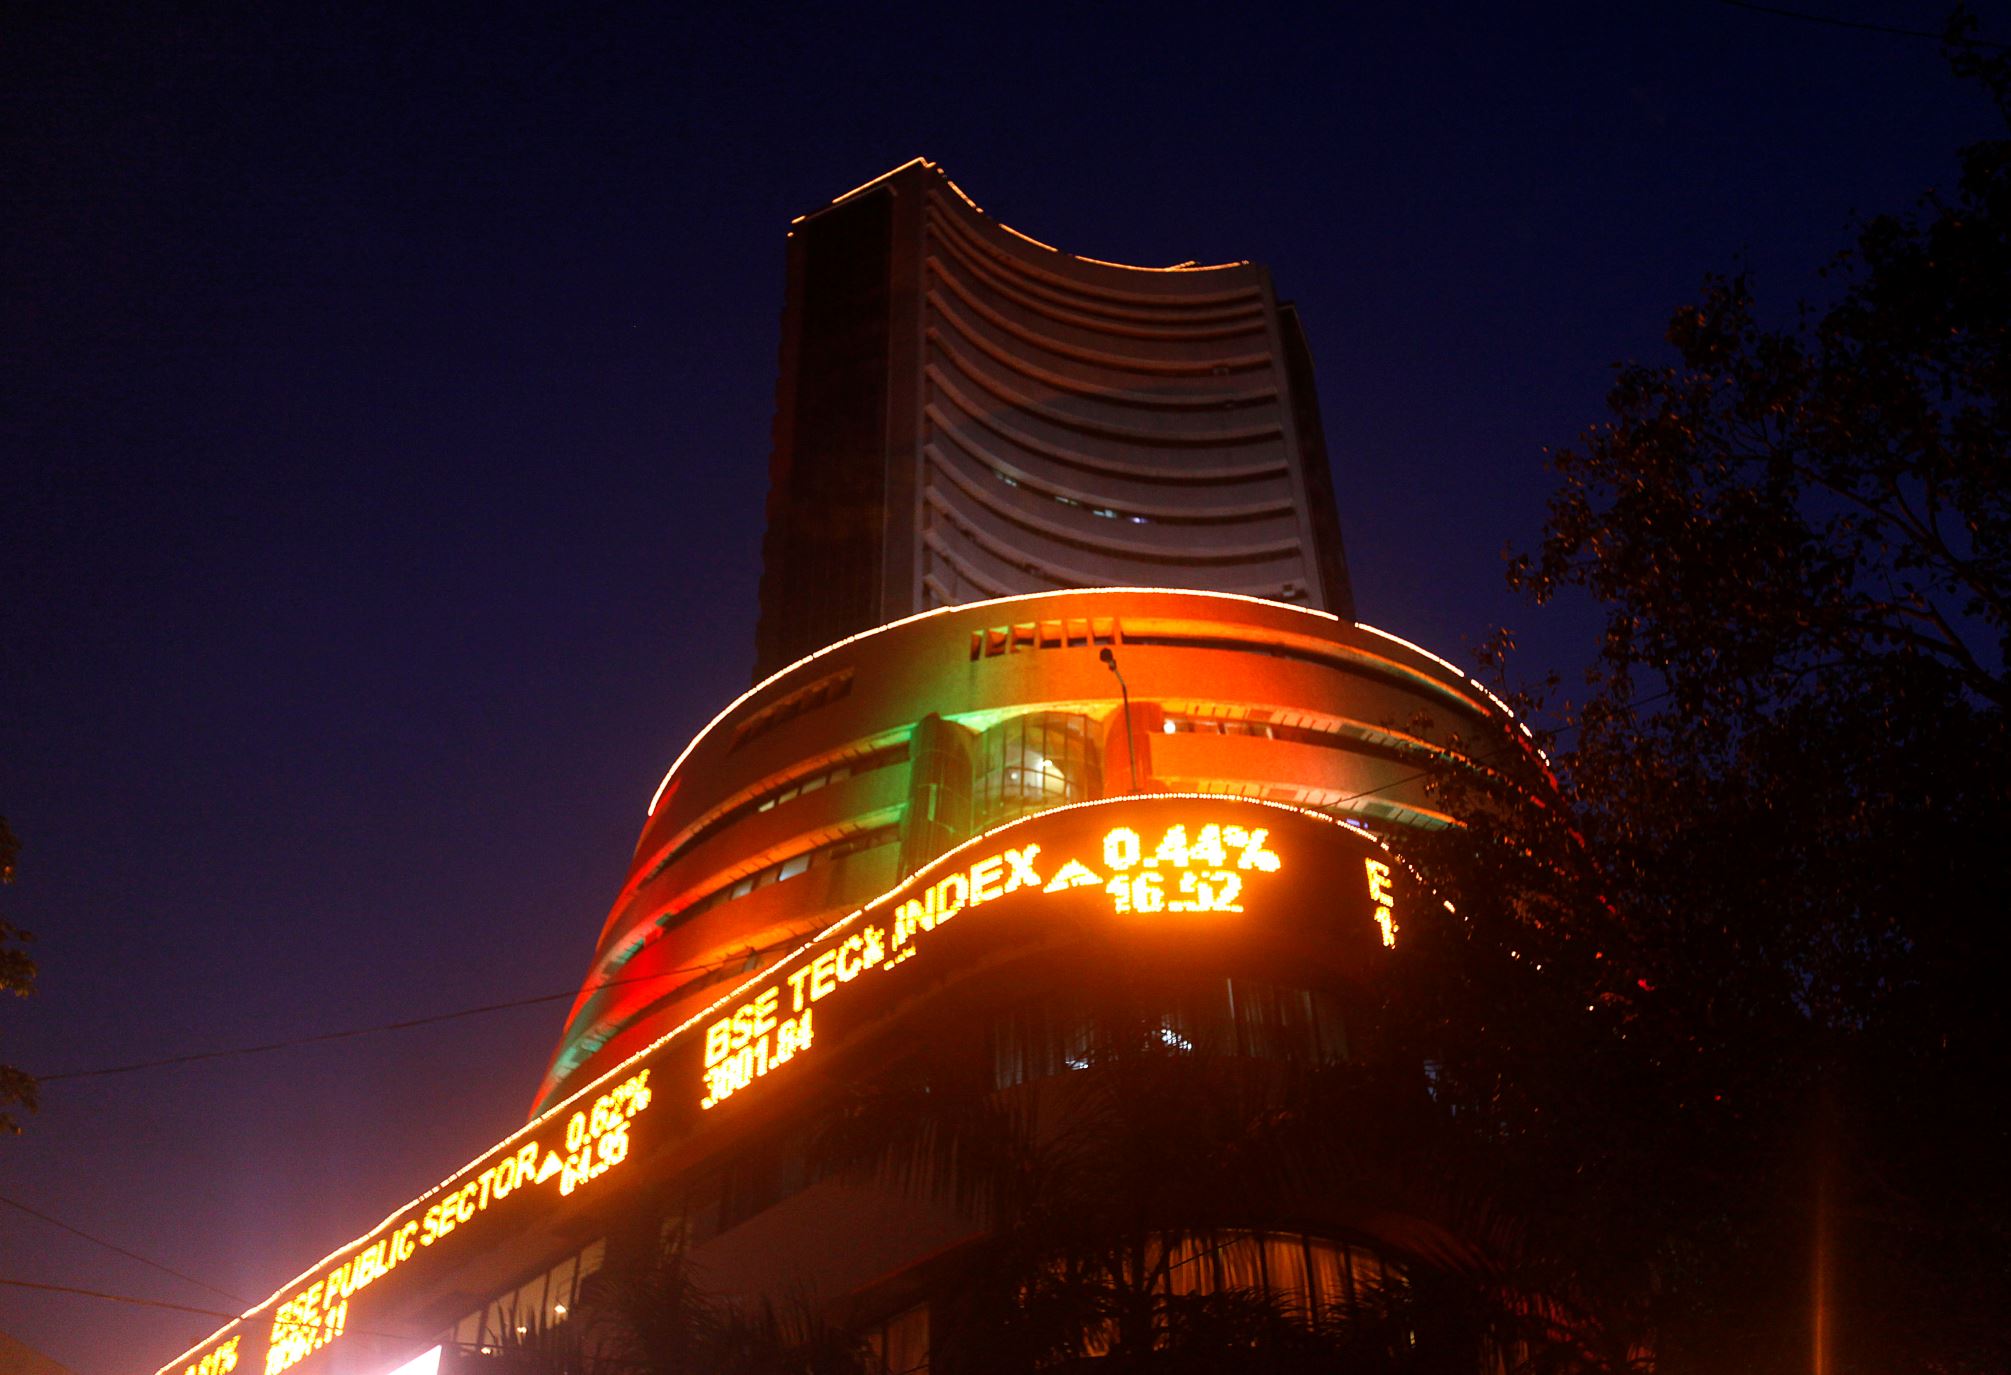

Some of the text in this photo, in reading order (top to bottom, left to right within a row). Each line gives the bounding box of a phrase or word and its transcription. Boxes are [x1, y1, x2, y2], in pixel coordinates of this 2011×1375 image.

[705, 986, 779, 1069] BSE
[893, 843, 1041, 951] INDEX
[1103, 823, 1281, 872] 0.44%
[323, 1220, 418, 1310] PUBLIC
[420, 1141, 539, 1246] SECTOR
